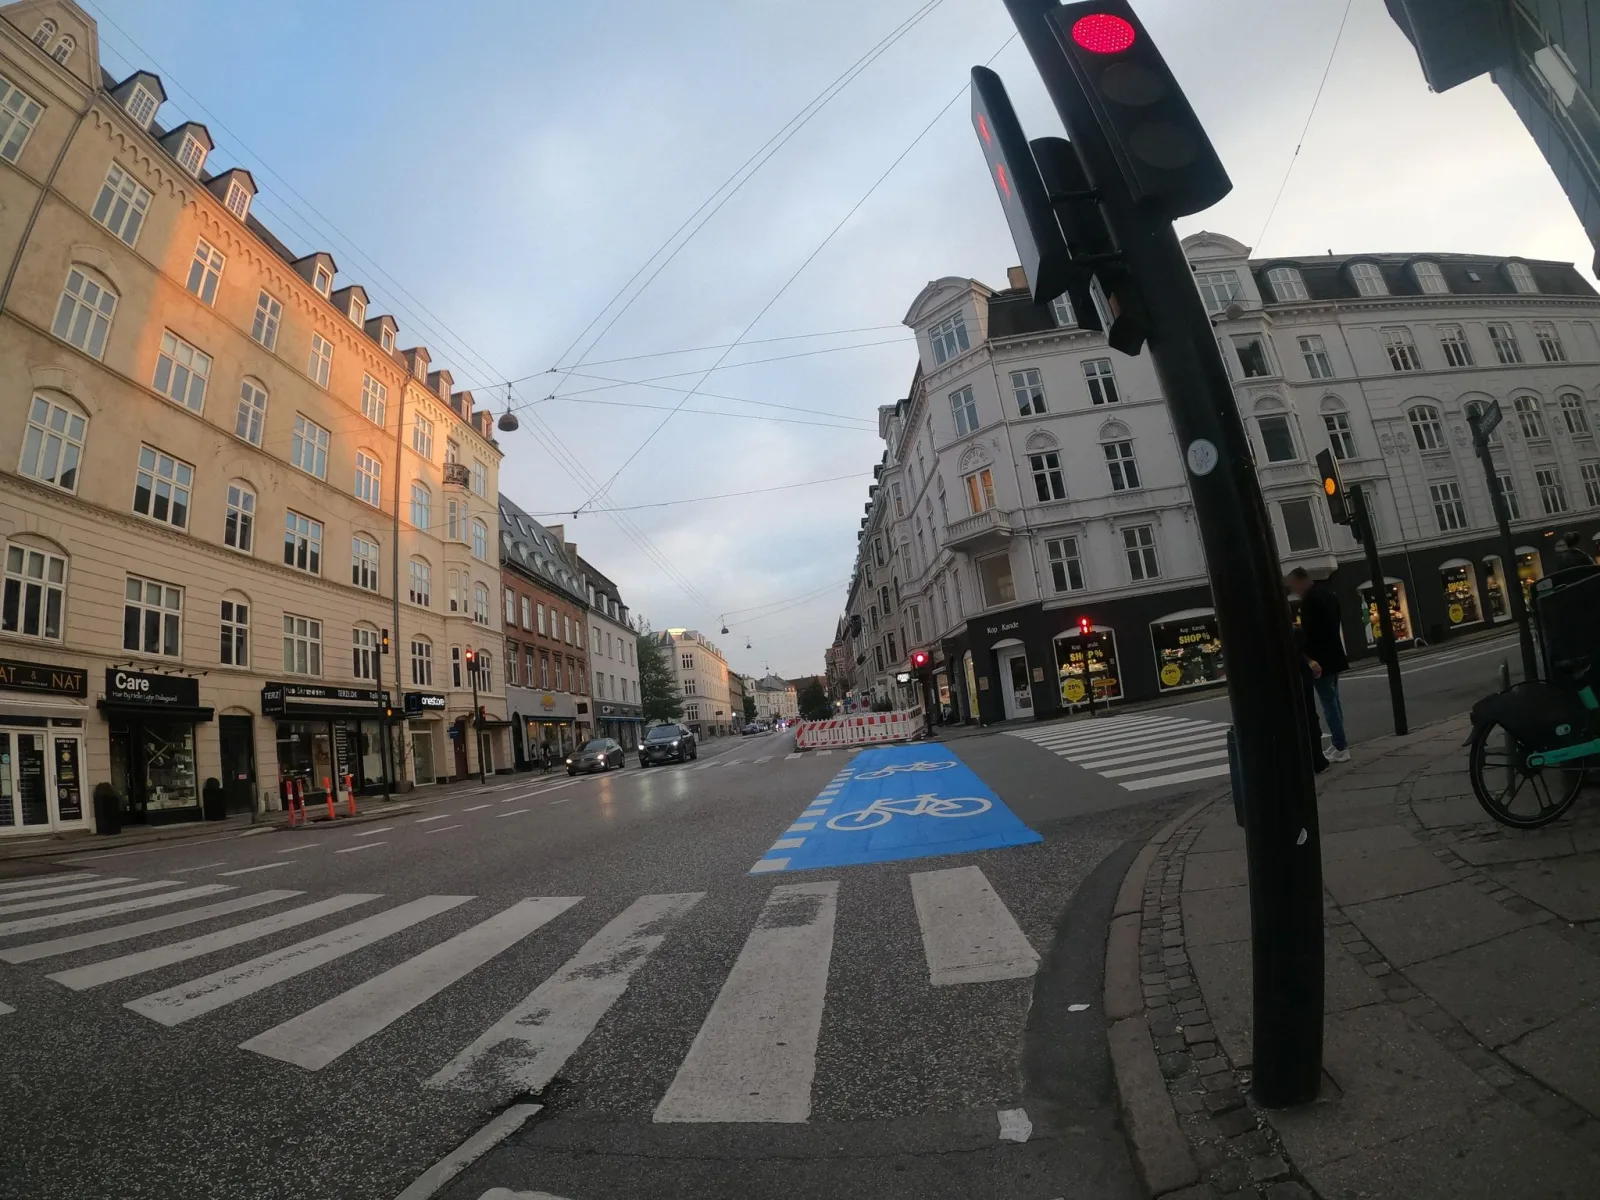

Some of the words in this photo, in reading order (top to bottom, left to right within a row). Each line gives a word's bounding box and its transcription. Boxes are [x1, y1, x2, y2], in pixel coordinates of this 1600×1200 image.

[30, 671, 37, 680] &
[52, 672, 82, 690] NAT
[115, 672, 150, 691] Care
[421, 696, 445, 706] onestore
